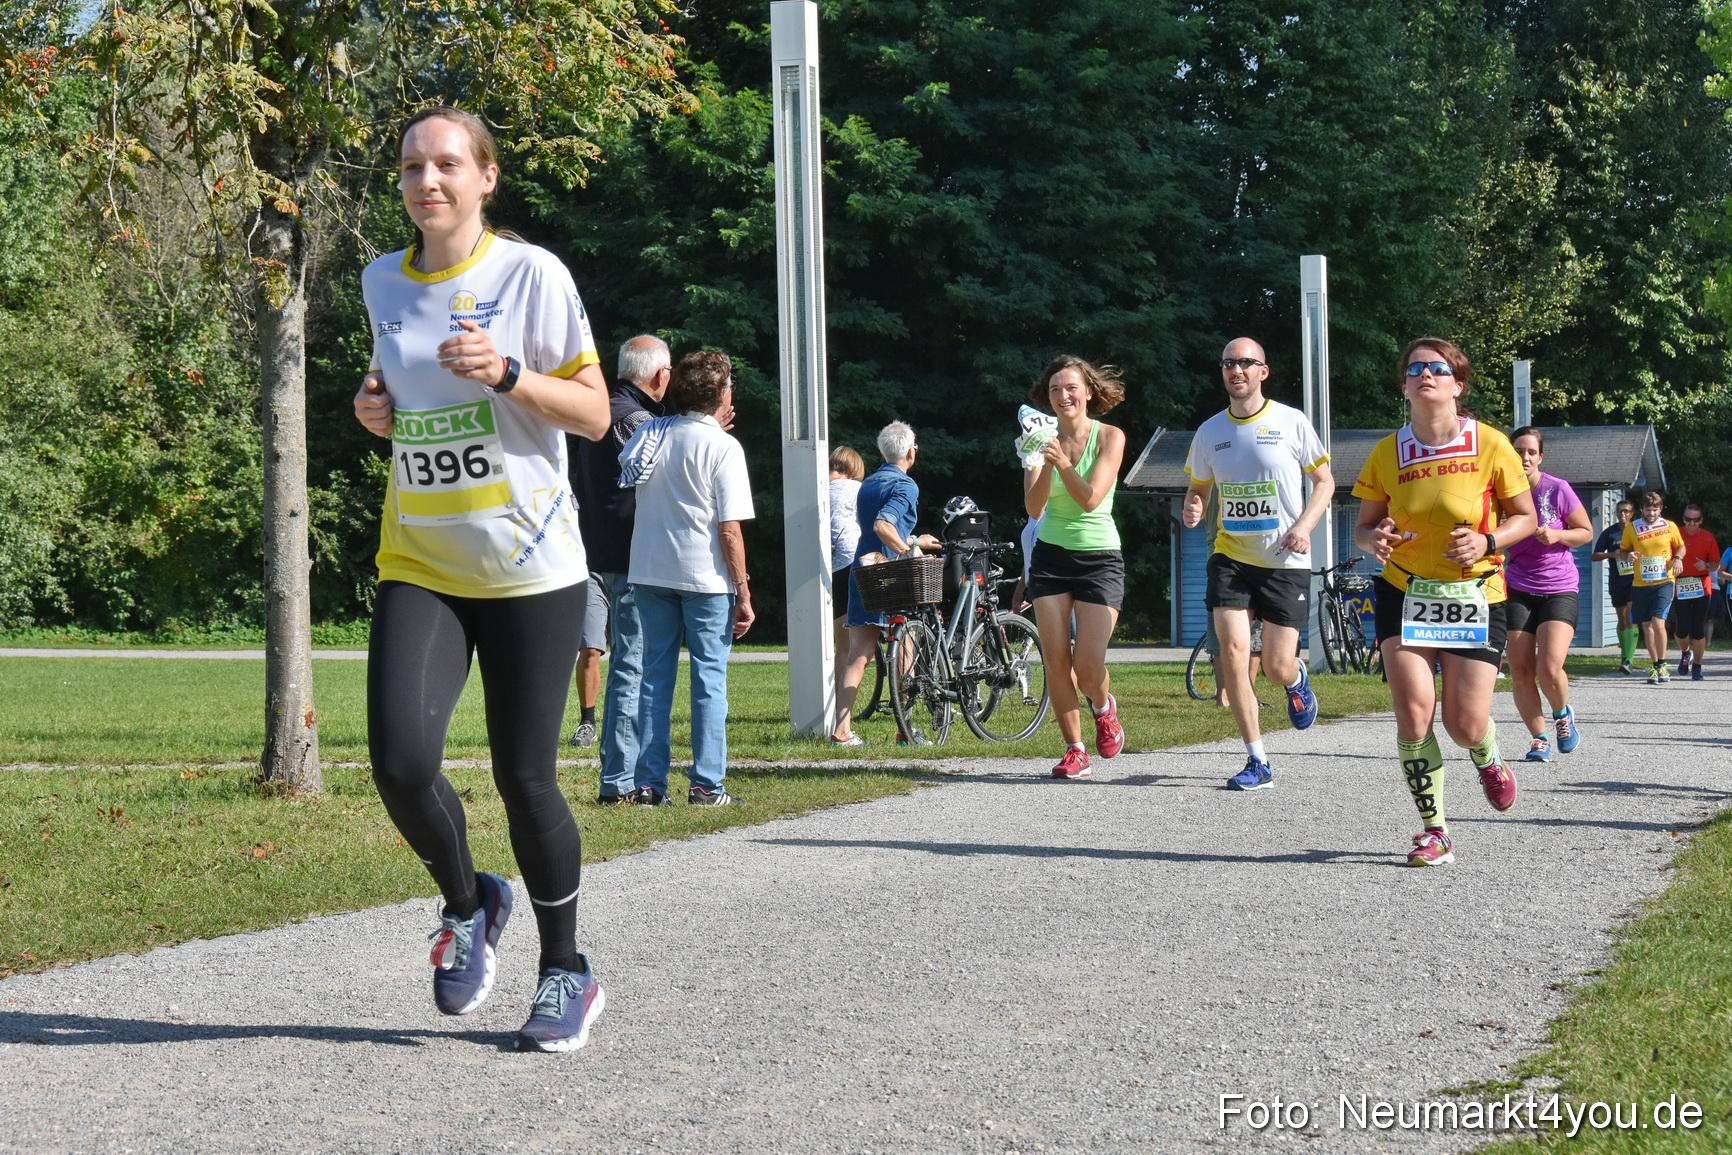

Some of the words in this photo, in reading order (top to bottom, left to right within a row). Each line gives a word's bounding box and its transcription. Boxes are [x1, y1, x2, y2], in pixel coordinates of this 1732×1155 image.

[451, 296, 475, 312] 20
[1257, 427, 1269, 435] 20
[400, 444, 490, 486] 1396
[1399, 467, 1432, 484] MAX
[1438, 461, 1479, 476] BÖGL
[1223, 484, 1272, 496] BOCK
[1227, 500, 1271, 517] 2804
[1232, 521, 1262, 530] Stefan
[1643, 564, 1664, 573] 2401
[1413, 581, 1475, 597] BOCK
[1680, 582, 1700, 593] 2555
[1413, 602, 1478, 623] 2382
[1414, 629, 1476, 639] MARKETA
